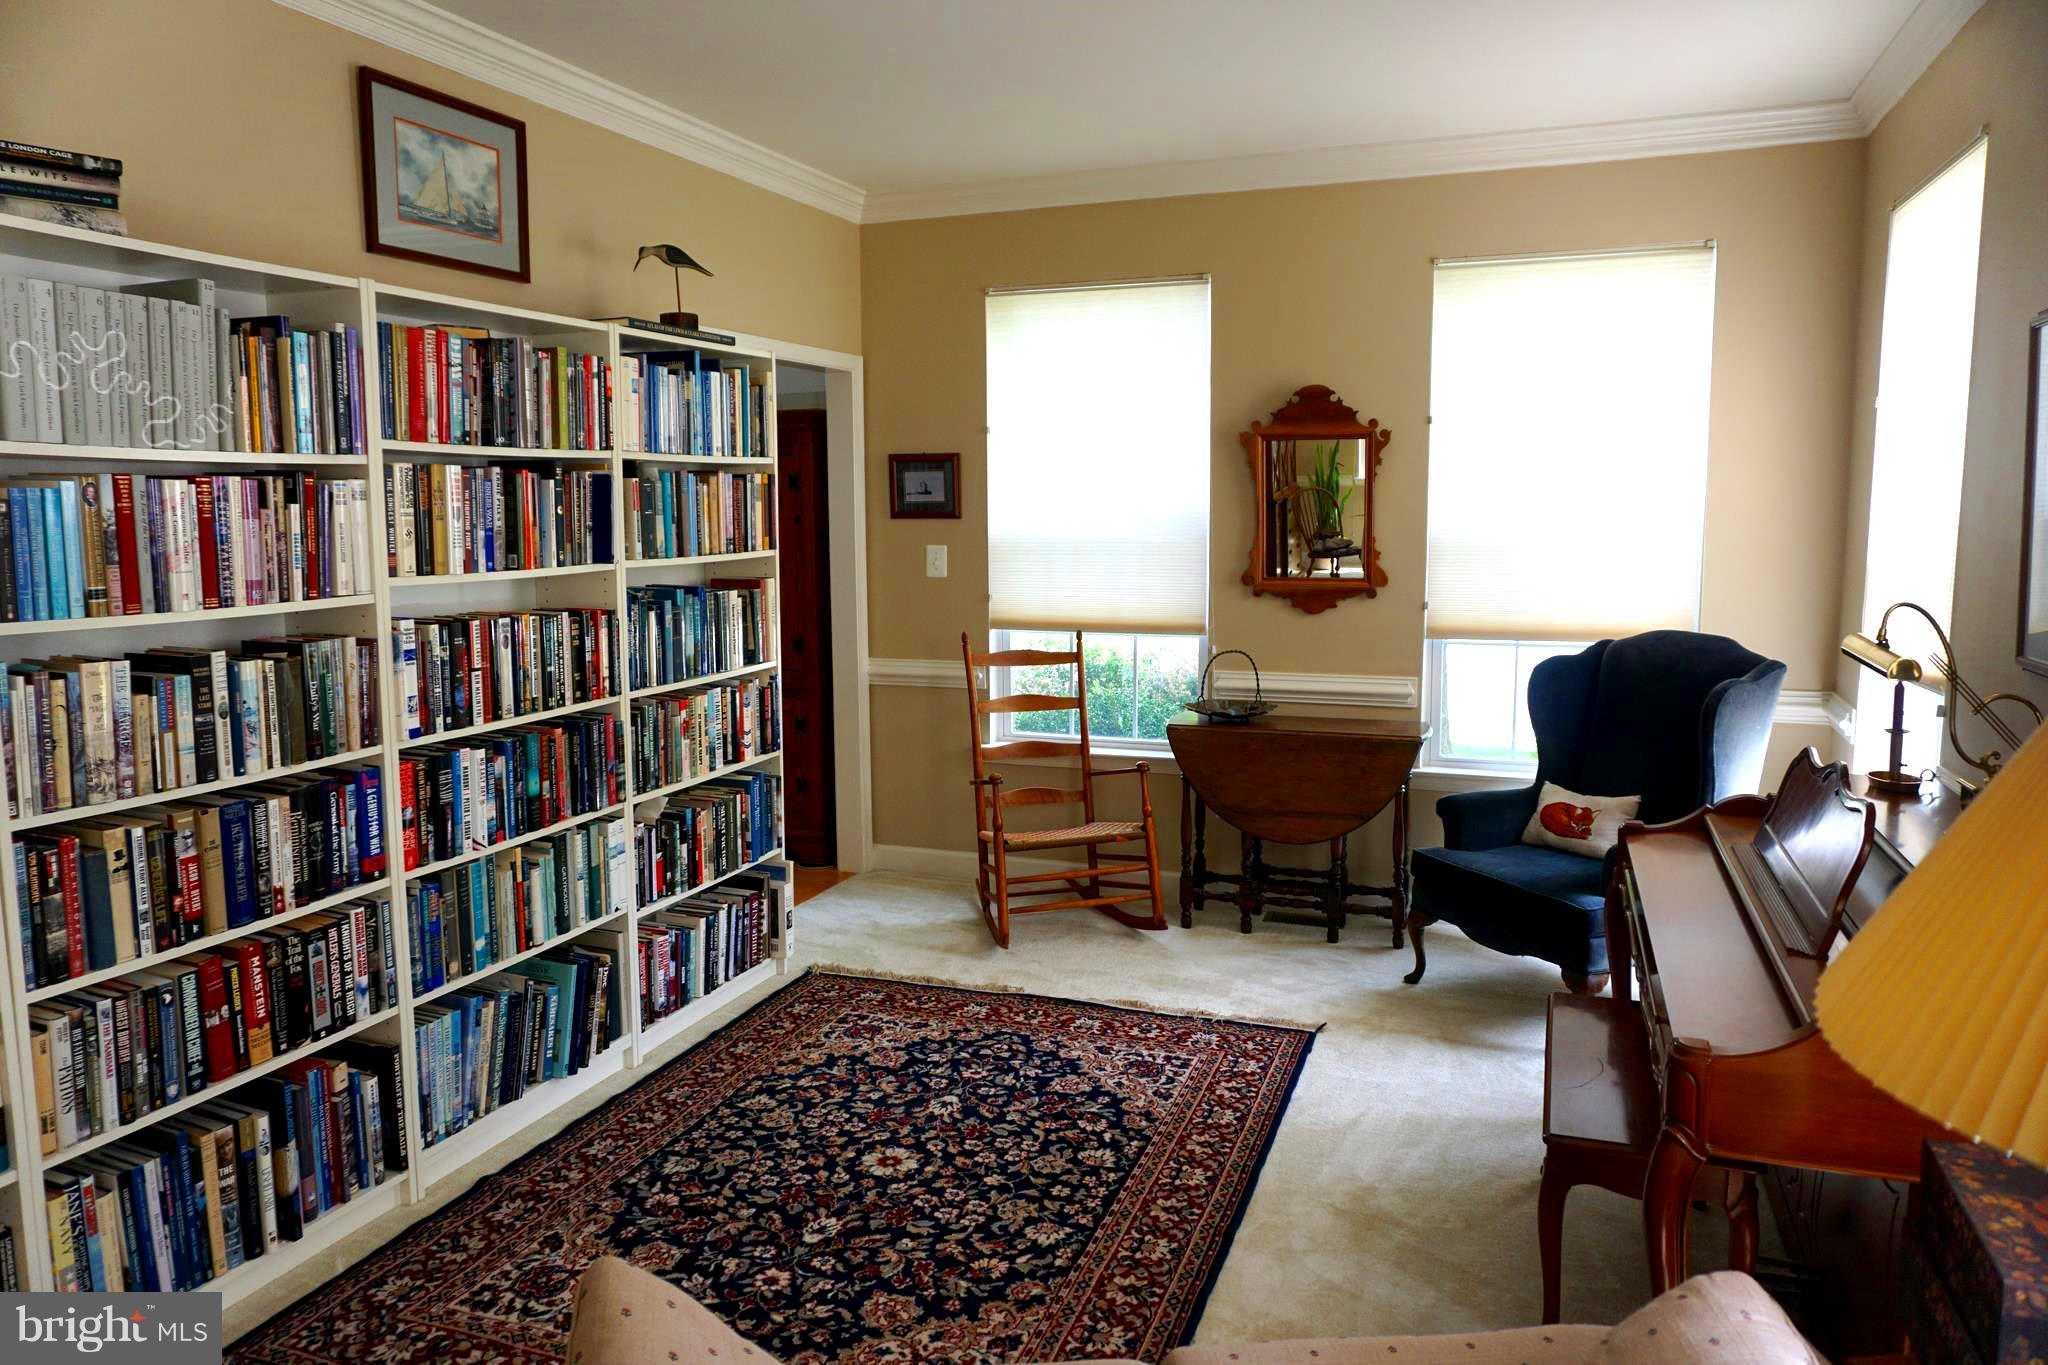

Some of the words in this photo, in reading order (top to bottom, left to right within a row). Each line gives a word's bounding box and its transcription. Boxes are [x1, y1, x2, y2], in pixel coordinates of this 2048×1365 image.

[8, 143, 48, 154] LONDON
[49, 150, 73, 160] CAGE
[28, 169, 70, 182] WITS
[69, 291, 77, 302] 5
[96, 296, 103, 306] 6
[451, 338, 462, 382] D-DAY
[46, 401, 54, 430] Expedition
[180, 491, 188, 538] Courageous
[218, 501, 228, 535] SIGN
[221, 545, 231, 597] TALKER
[116, 666, 128, 692] THE
[214, 654, 226, 693] CUSTER
[309, 681, 318, 712] Duffy's
[41, 698, 51, 734] BATTLE
[117, 698, 130, 748] CHARGE
[312, 714, 320, 731] War
[44, 738, 52, 752] OF
[46, 756, 54, 784] PAOLI
[479, 758, 485, 766] NO
[418, 771, 426, 800] HUNTING
[439, 769, 453, 805] CRUSADE
[330, 792, 340, 824] General
[368, 794, 376, 820] GENIUS
[231, 823, 242, 839] IKE
[254, 804, 268, 849] PARATROOPER
[331, 825, 339, 834] of
[369, 822, 378, 837] FOR
[407, 828, 415, 850] DARK
[420, 810, 428, 845] EICHMANN
[136, 836, 144, 864] TERRIBLE
[232, 842, 244, 860] THE
[290, 811, 303, 884] Reminiscences
[332, 836, 340, 850] the
[370, 839, 380, 856] WAR
[28, 852, 38, 866] VON
[188, 862, 199, 881] JACOB
[331, 852, 341, 875] Army
[29, 868, 41, 904] RICHTHOFEN
[138, 865, 146, 885] TERRY
[150, 856, 167, 904] GENERAL'S
[234, 862, 247, 902] SOLDIER
[69, 853, 82, 951] RICHTHOFEN
[140, 886, 148, 906] ALLEN
[191, 890, 201, 912] DEVERS
[156, 905, 168, 926] LIFE
[286, 936, 300, 945] The
[287, 944, 302, 955] Trail
[328, 928, 339, 959] HITLER'S
[341, 924, 351, 960] KNIGHTS
[285, 958, 294, 966] of
[294, 954, 304, 963] the
[290, 966, 302, 974] Fox
[344, 963, 352, 972] OF
[230, 967, 240, 989] PANZER
[251, 956, 266, 1019] MANSTEIN
[330, 960, 341, 998] GENERALS
[345, 975, 353, 990] THE
[181, 974, 198, 1030] COMMANDER
[232, 990, 242, 1012] LEADER
[346, 992, 355, 1016] REICH
[498, 996, 507, 1014] Men,
[115, 1000, 128, 1030] BIGGEST
[496, 1014, 505, 1039] Ships,
[546, 994, 557, 1048] NAMESAKES
[72, 1028, 82, 1041] HIS
[103, 1023, 112, 1037] THE
[188, 1031, 200, 1039] IN
[534, 1030, 539, 1038] OF
[72, 1042, 84, 1075] FATHER'S
[104, 1039, 114, 1079] NAMESAKE
[118, 1031, 130, 1063] BROTHER
[188, 1041, 202, 1063] CHIEF
[76, 1077, 86, 1089] SON
[393, 1053, 401, 1096] PORTRAIT
[57, 1066, 73, 1114] PATTONS
[284, 1085, 295, 1141] HIMALAYAS
[396, 1099, 402, 1108] OF
[324, 1102, 332, 1150] PENNSYLVANIA
[64, 1184, 83, 1236] JANE'S
[59, 1215, 72, 1256] NAVY
